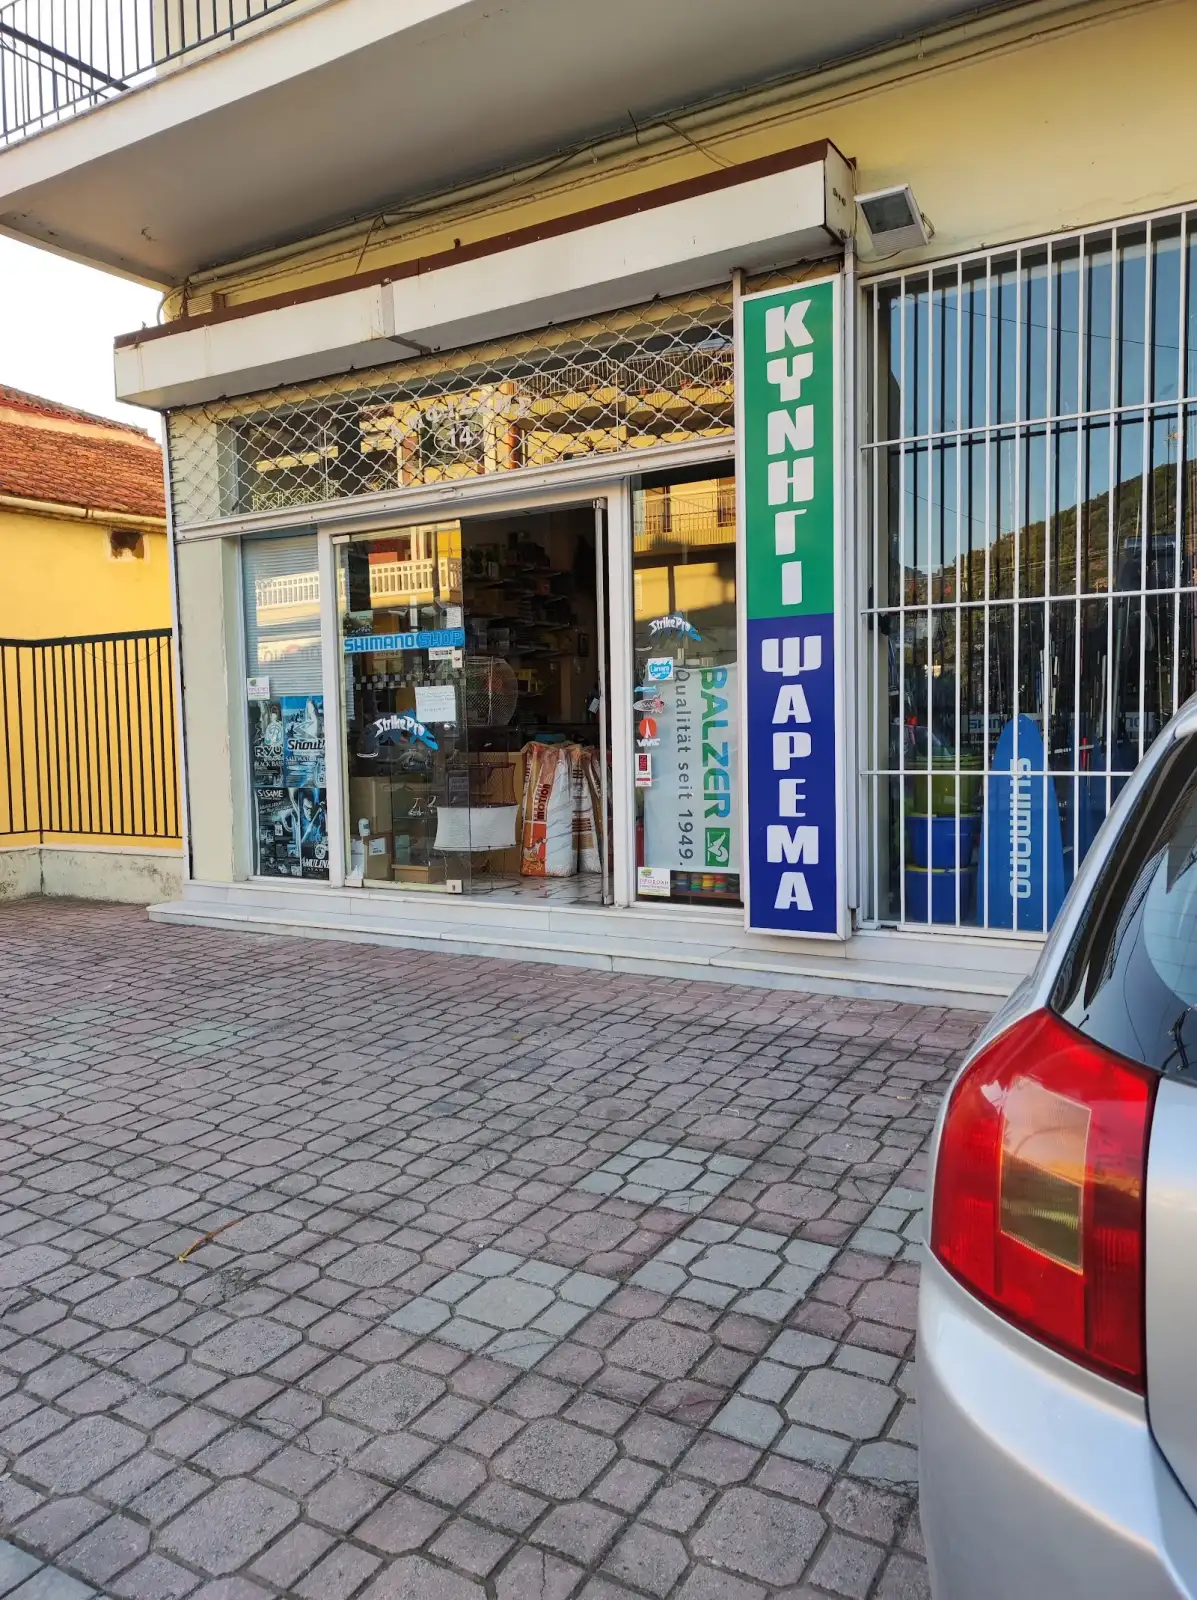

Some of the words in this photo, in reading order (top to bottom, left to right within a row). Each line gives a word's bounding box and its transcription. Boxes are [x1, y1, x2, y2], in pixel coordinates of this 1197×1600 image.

[447, 425, 473, 448] 14
[765, 299, 814, 606] ΚΥΝΗΓΙ
[344, 634, 413, 652] SHIMANO
[420, 631, 461, 647] SHOP
[674, 669, 692, 753] Qualität
[699, 667, 731, 819] BALZER
[678, 762, 693, 801] seit
[761, 635, 822, 911] ΨΑΡΕΜΑ
[679, 809, 694, 866] 1949.
